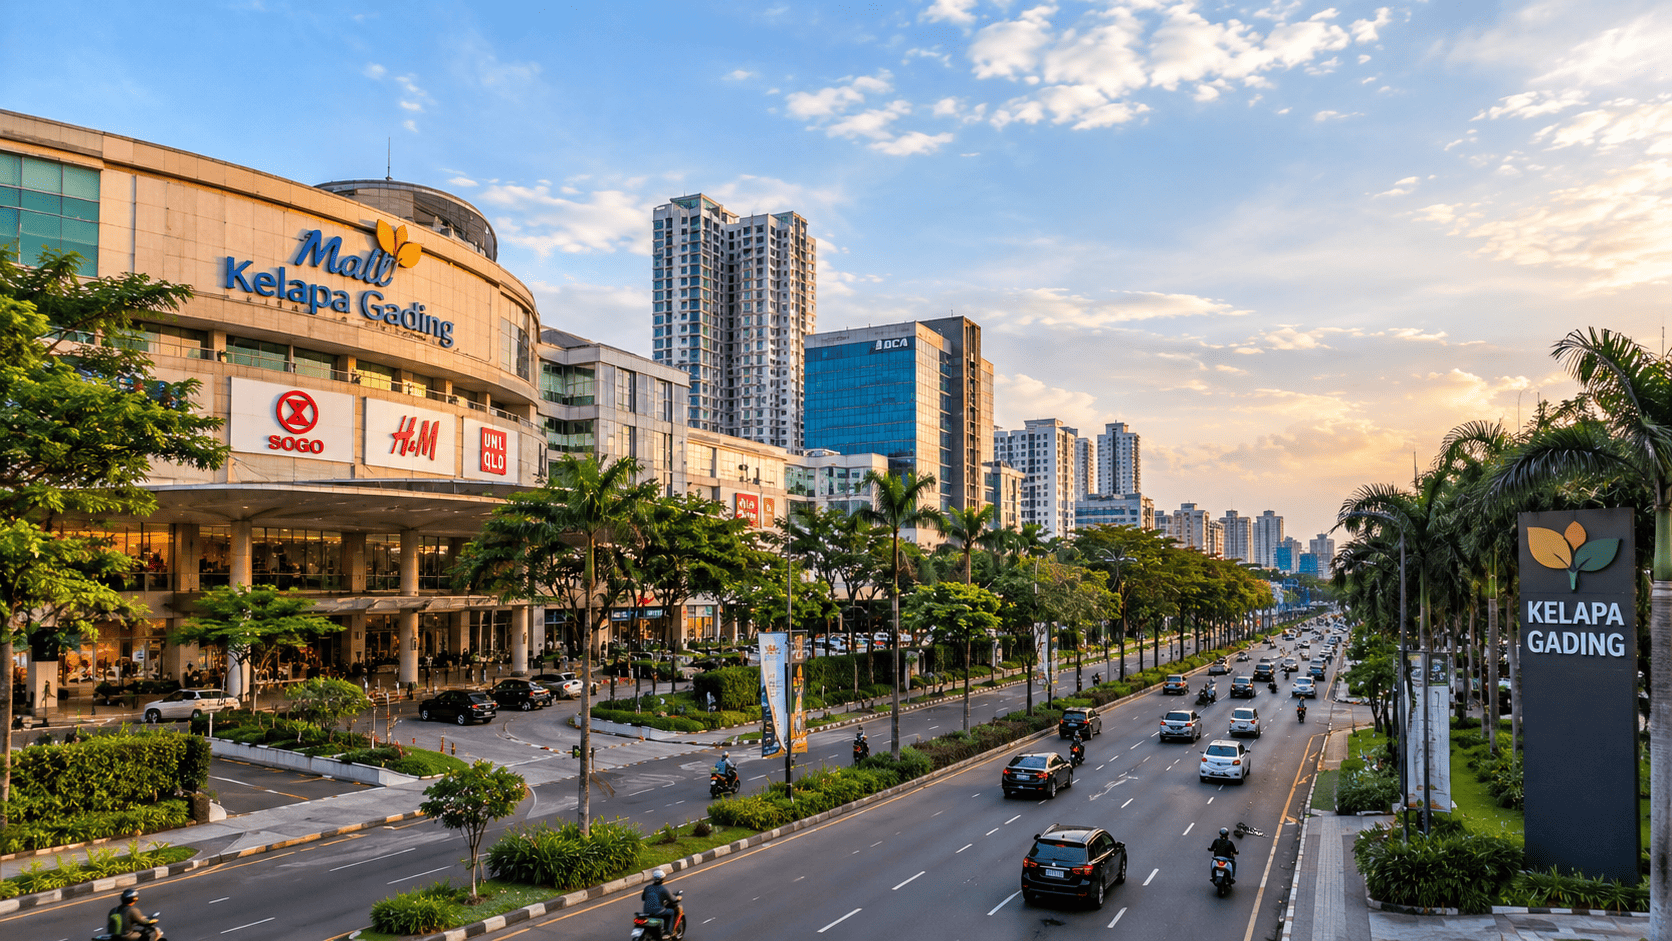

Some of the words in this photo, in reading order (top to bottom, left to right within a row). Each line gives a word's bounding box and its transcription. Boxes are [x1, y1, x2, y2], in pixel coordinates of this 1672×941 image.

[295, 229, 397, 287] Mall
[226, 256, 350, 315] Kelapa
[361, 290, 454, 348] Gading
[268, 434, 325, 455] SOGO
[391, 415, 440, 461] H&M
[1527, 600, 1625, 626] KELAPA
[1527, 630, 1625, 657] GADING
